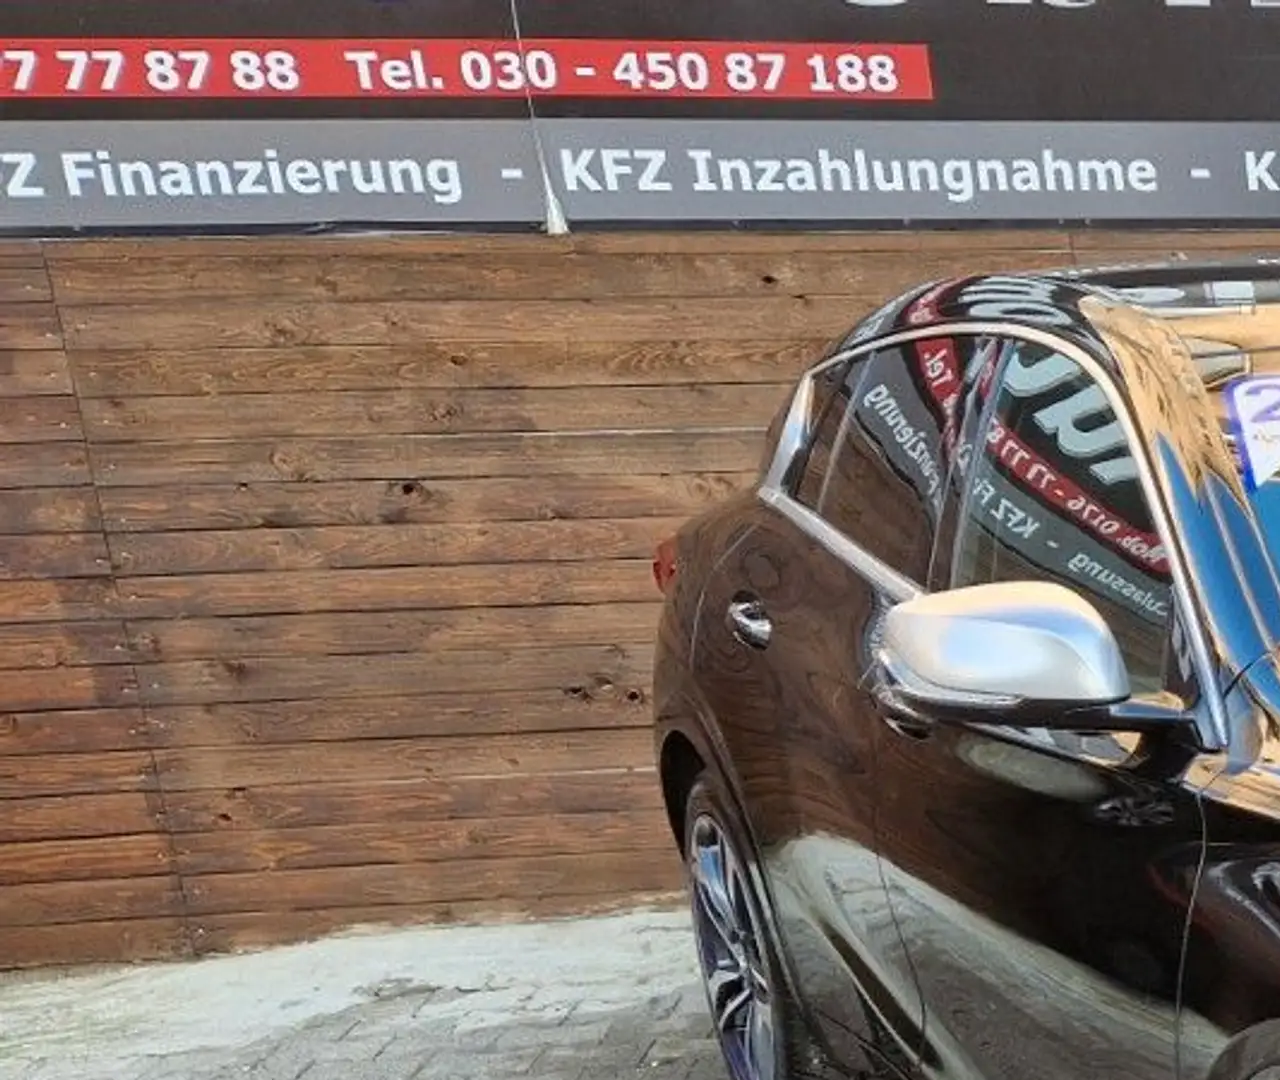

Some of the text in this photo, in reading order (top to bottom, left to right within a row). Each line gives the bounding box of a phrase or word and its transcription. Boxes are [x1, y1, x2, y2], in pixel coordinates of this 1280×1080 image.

[56, 51, 123, 91] 77
[144, 51, 209, 92] 87
[229, 51, 300, 92] 88
[343, 50, 444, 90] Tel.
[460, 51, 556, 91] 030
[575, 67, 597, 77] -
[612, 51, 709, 91] 450
[725, 53, 785, 92] 87
[807, 54, 899, 93] 188
[60, 149, 463, 204] Finanzierung
[501, 168, 523, 181] -
[559, 149, 672, 192] KFZ
[687, 149, 1158, 202] Inzahlungnahme
[1190, 168, 1211, 180] -
